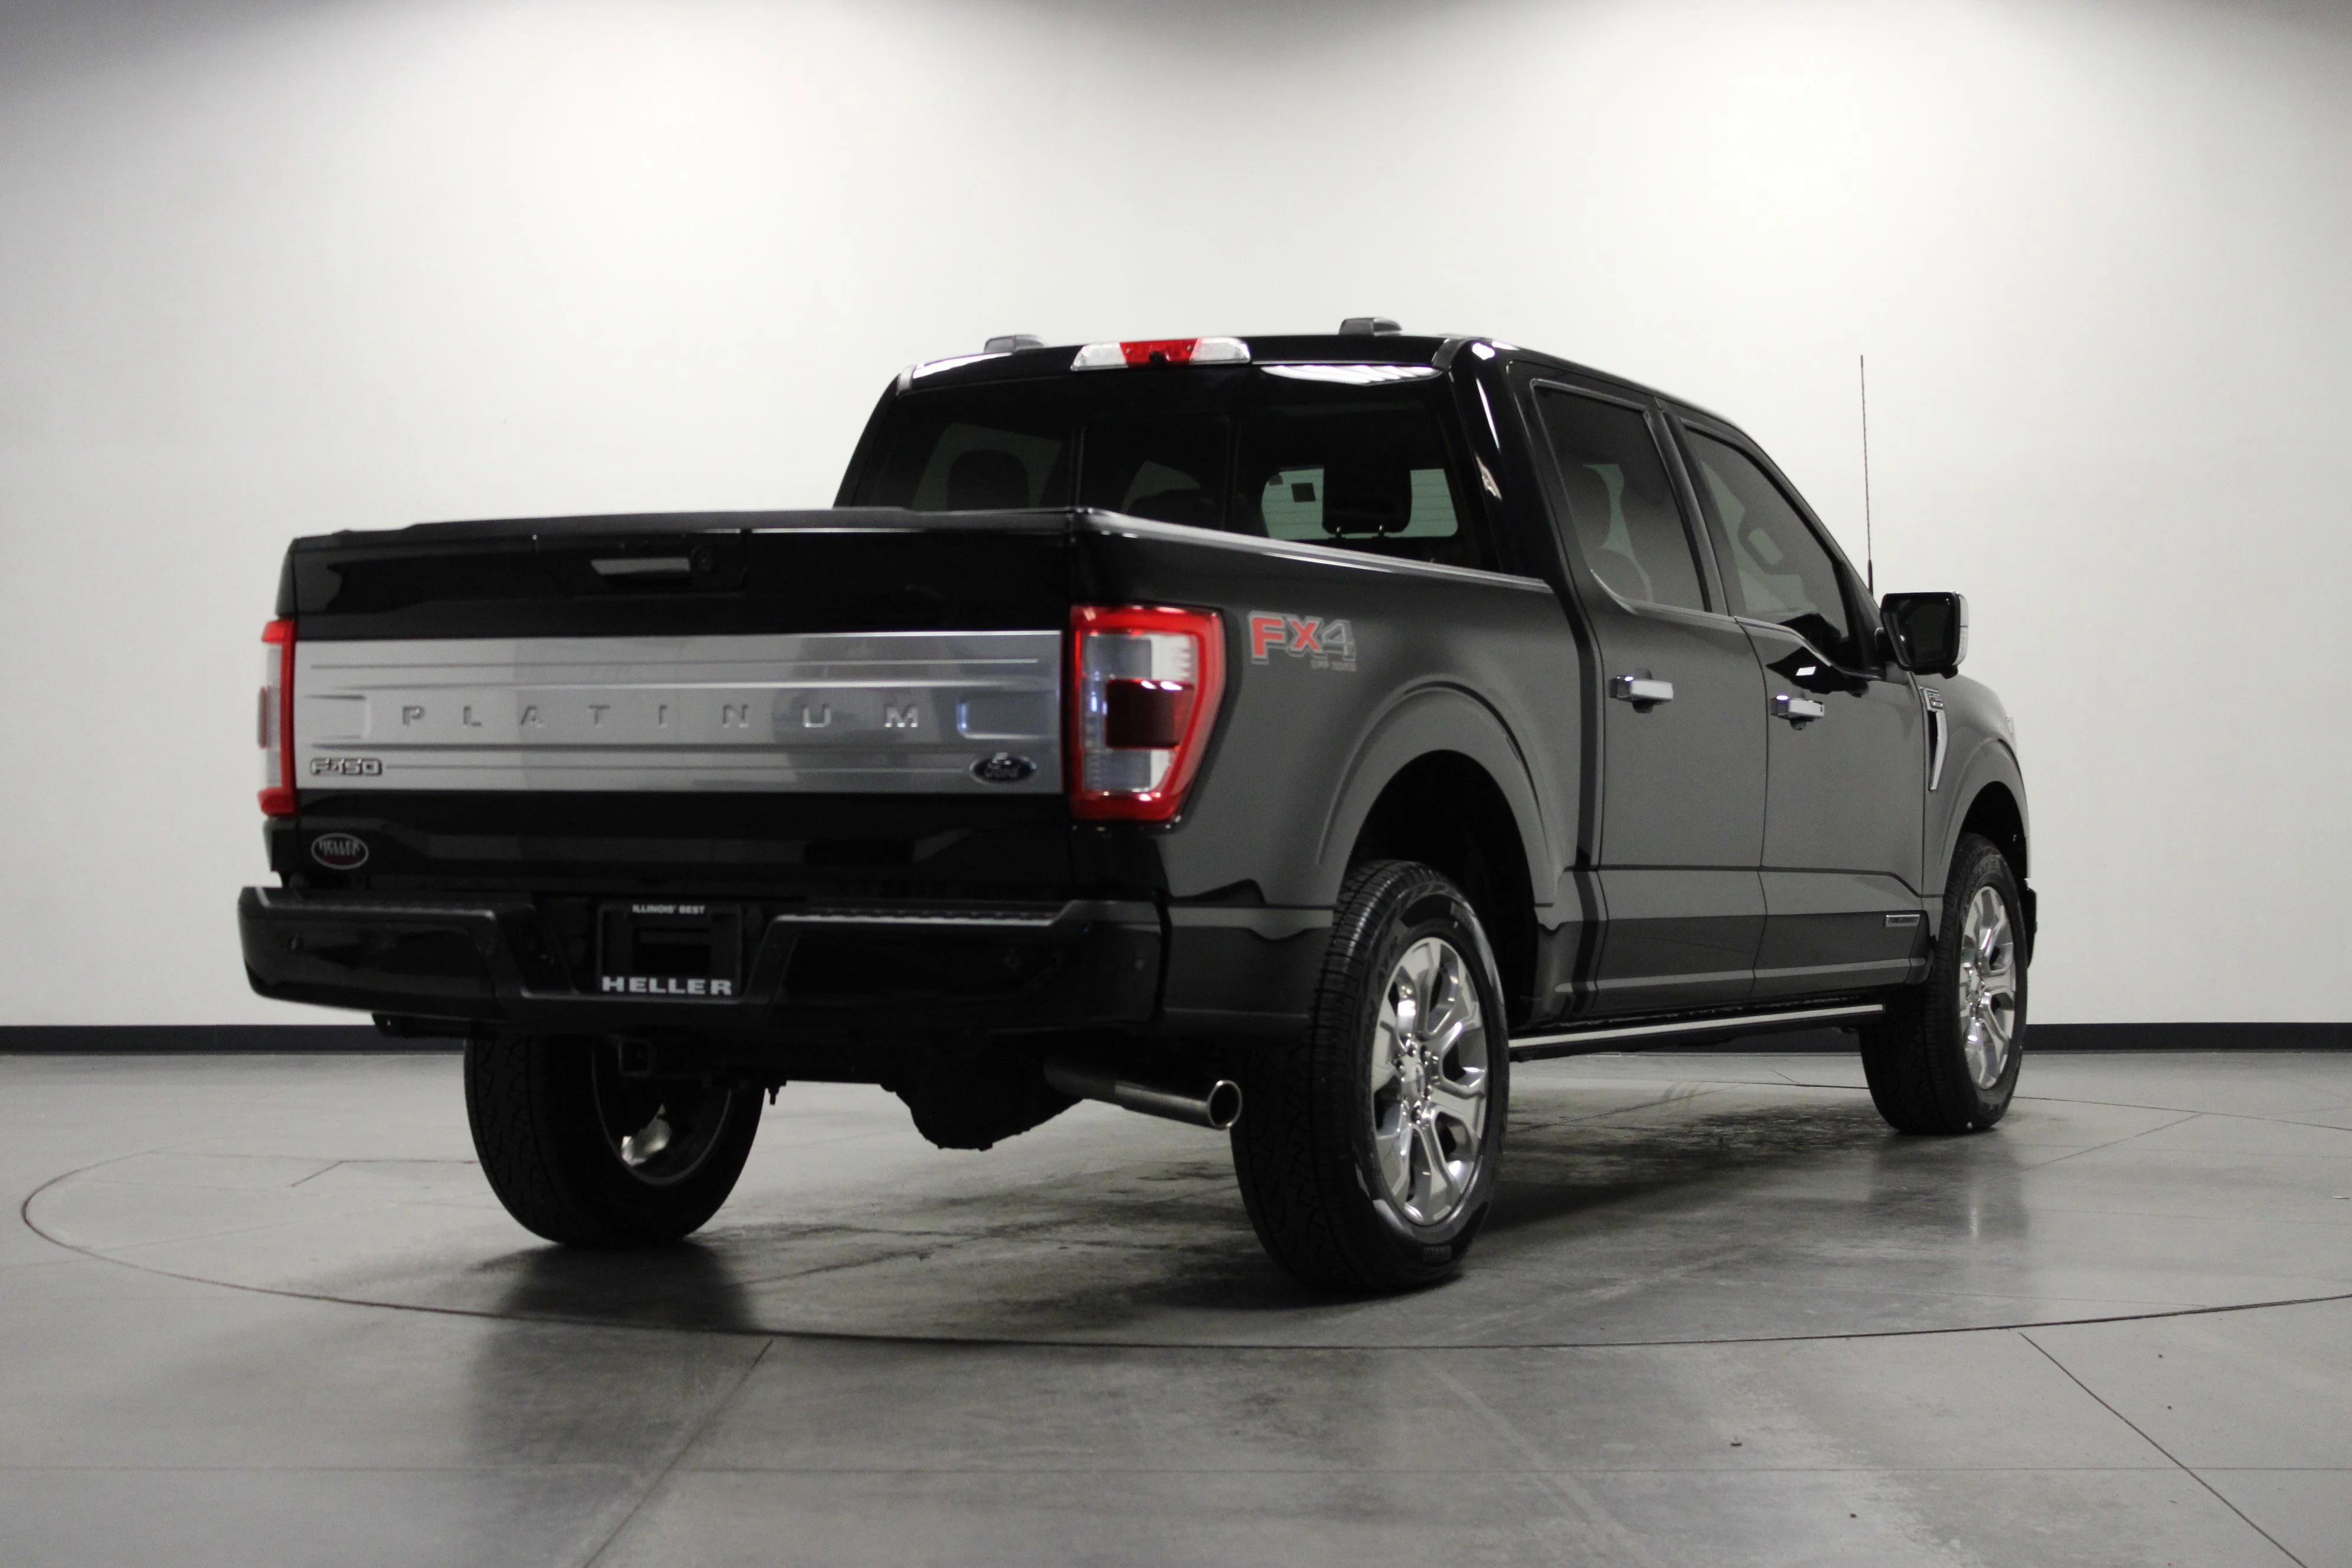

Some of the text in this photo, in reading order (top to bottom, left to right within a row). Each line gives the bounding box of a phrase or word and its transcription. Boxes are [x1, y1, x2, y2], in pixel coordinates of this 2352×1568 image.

[1248, 611, 1356, 665] FX4
[402, 704, 919, 729] PLATINUM
[601, 975, 732, 996] HELLER
